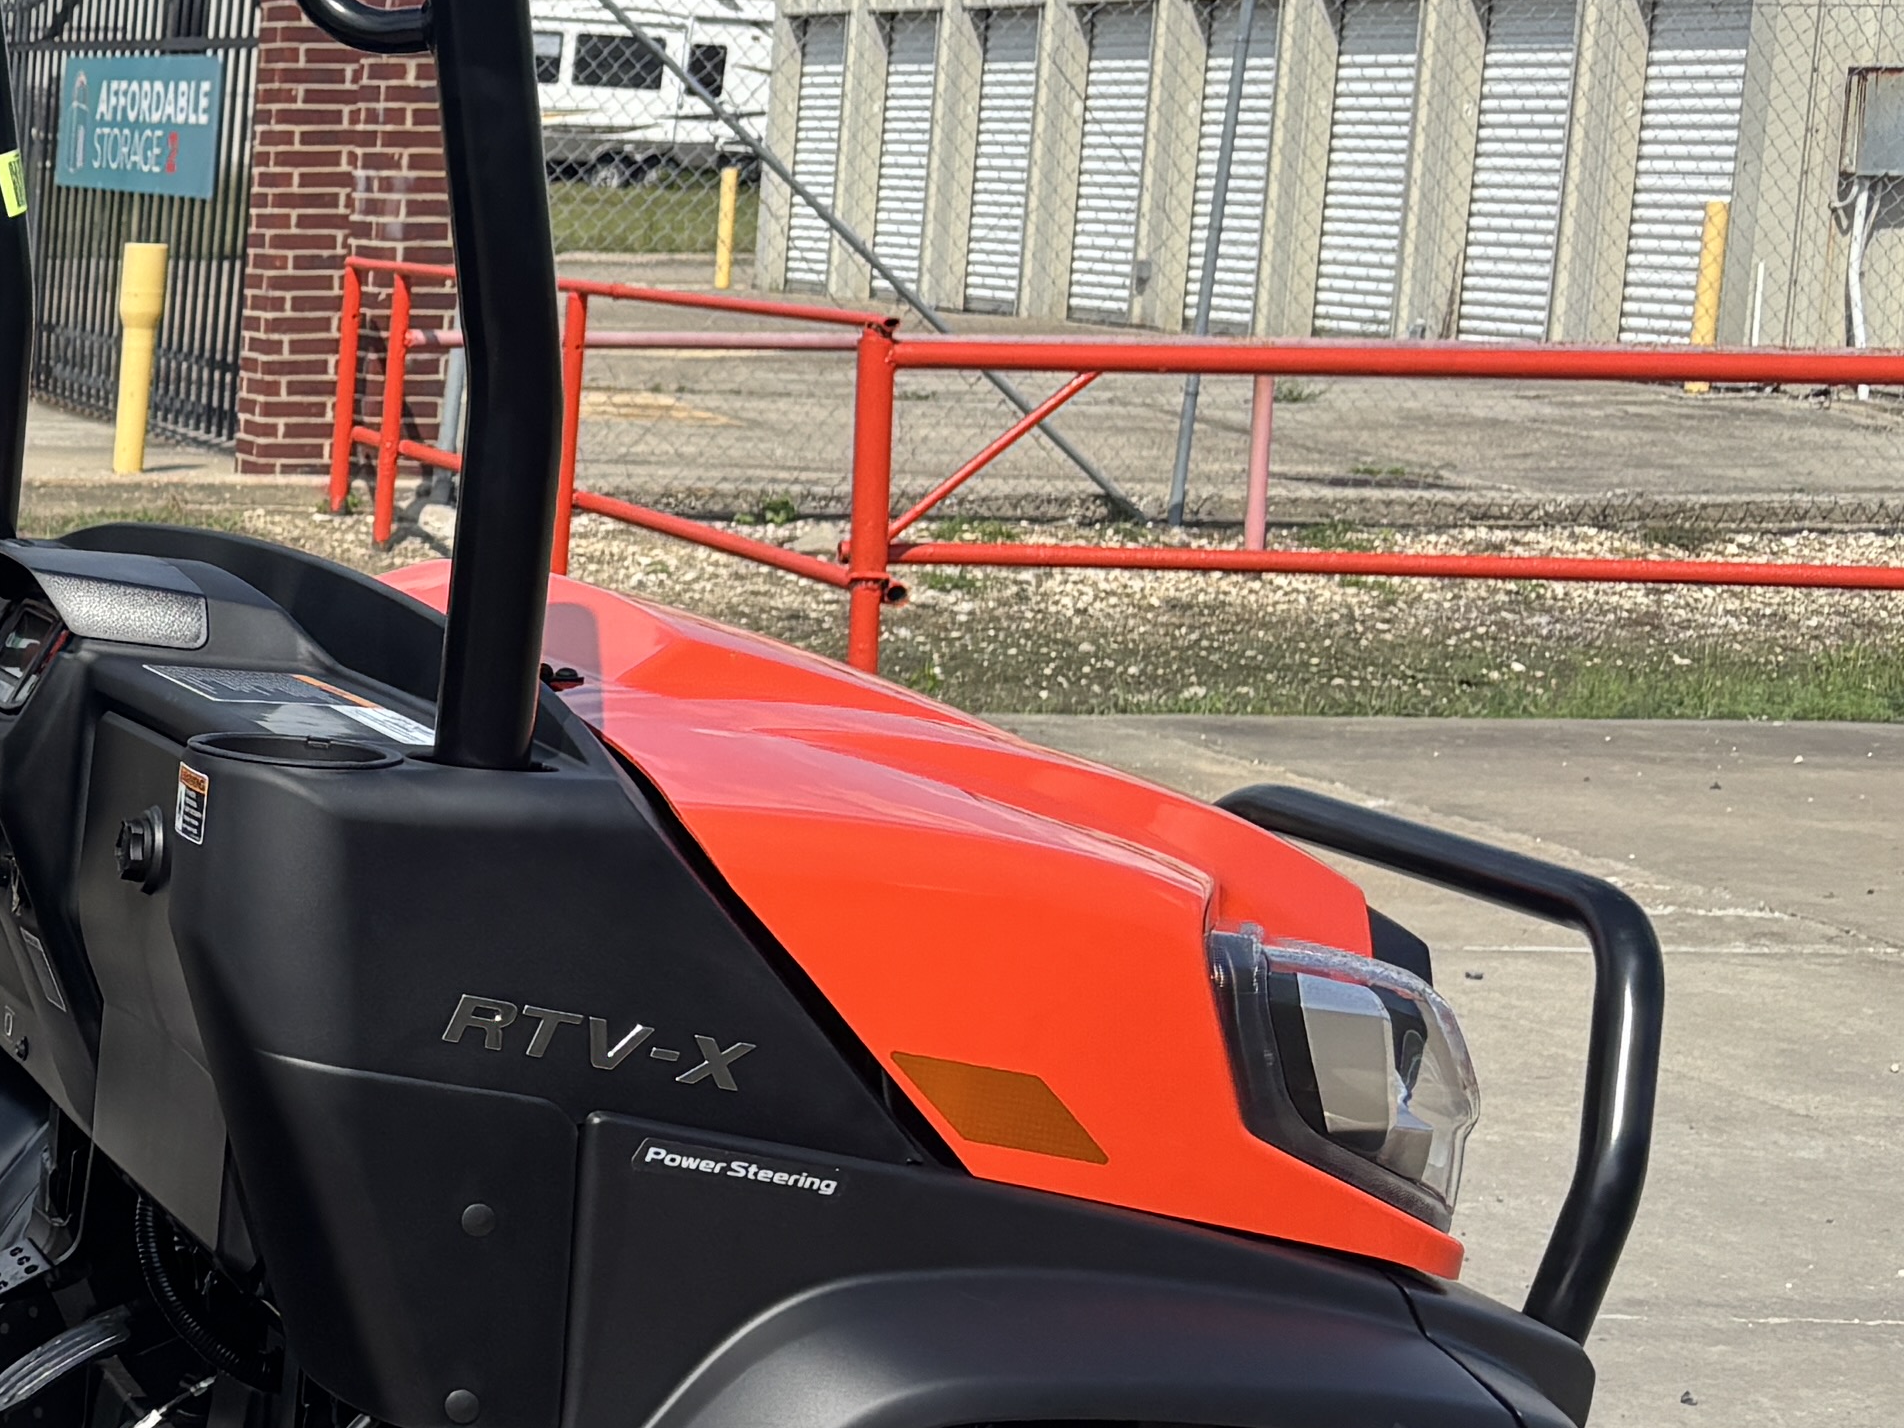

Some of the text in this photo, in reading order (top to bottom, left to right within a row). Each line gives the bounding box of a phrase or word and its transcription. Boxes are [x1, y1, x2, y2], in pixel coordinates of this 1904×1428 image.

[96, 80, 212, 125] AFFORDABLE
[92, 128, 178, 174] STORAGE 2
[442, 994, 757, 1092] RTV-X
[645, 1146, 838, 1197] Power Steering
